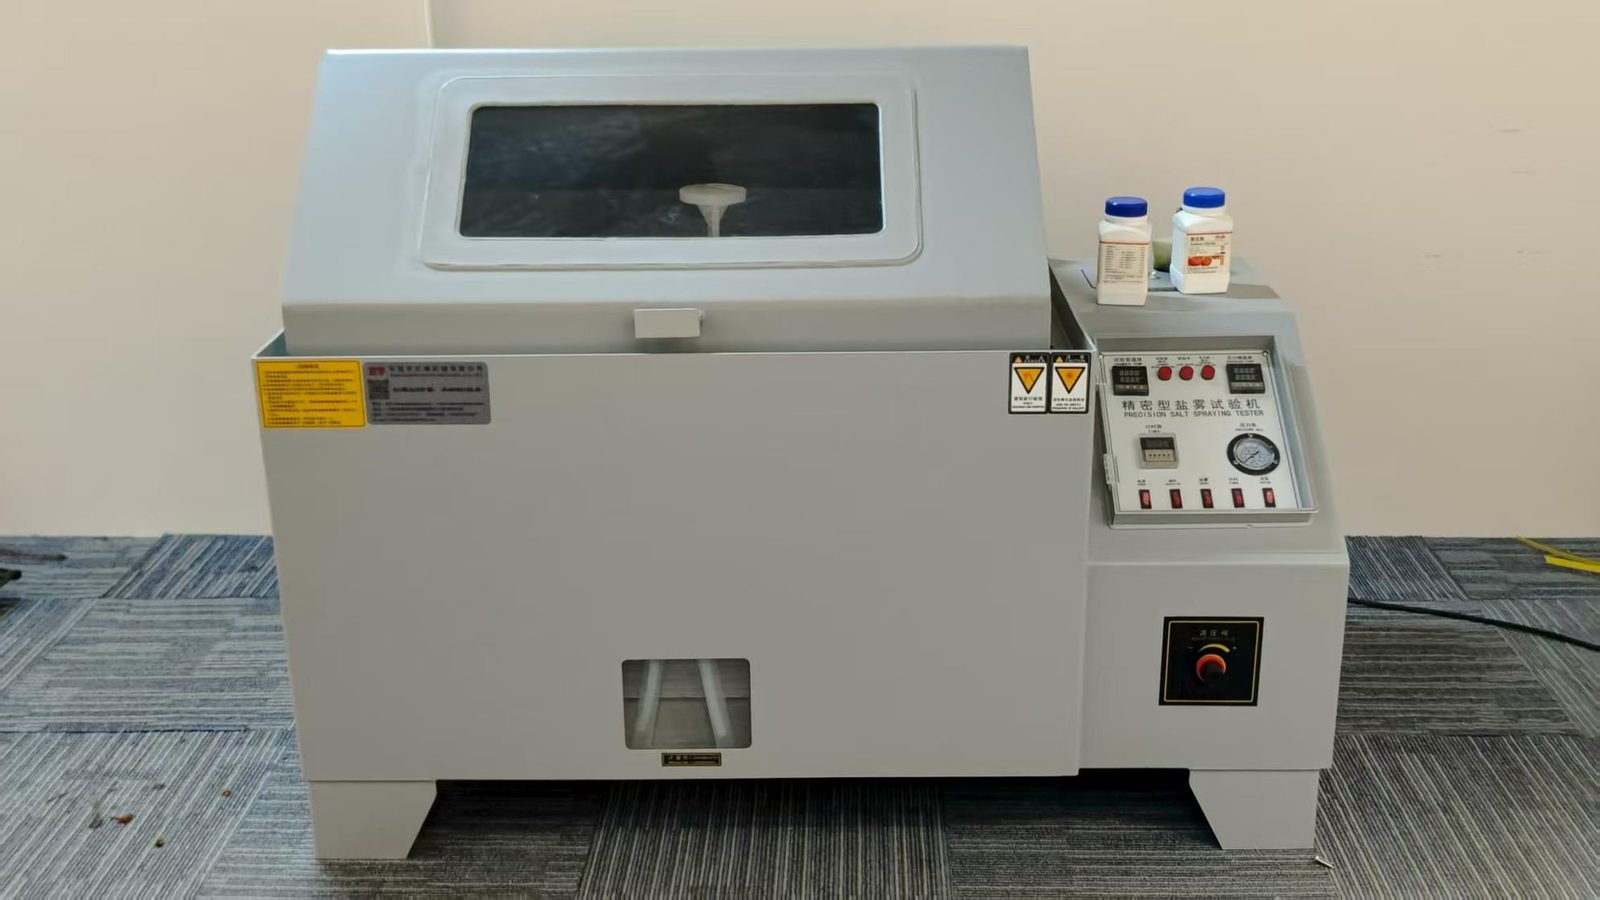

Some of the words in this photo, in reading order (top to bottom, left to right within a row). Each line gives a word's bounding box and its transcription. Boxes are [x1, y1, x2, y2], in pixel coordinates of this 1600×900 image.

[1121, 399, 1261, 411] 精密型盐雾试验机
